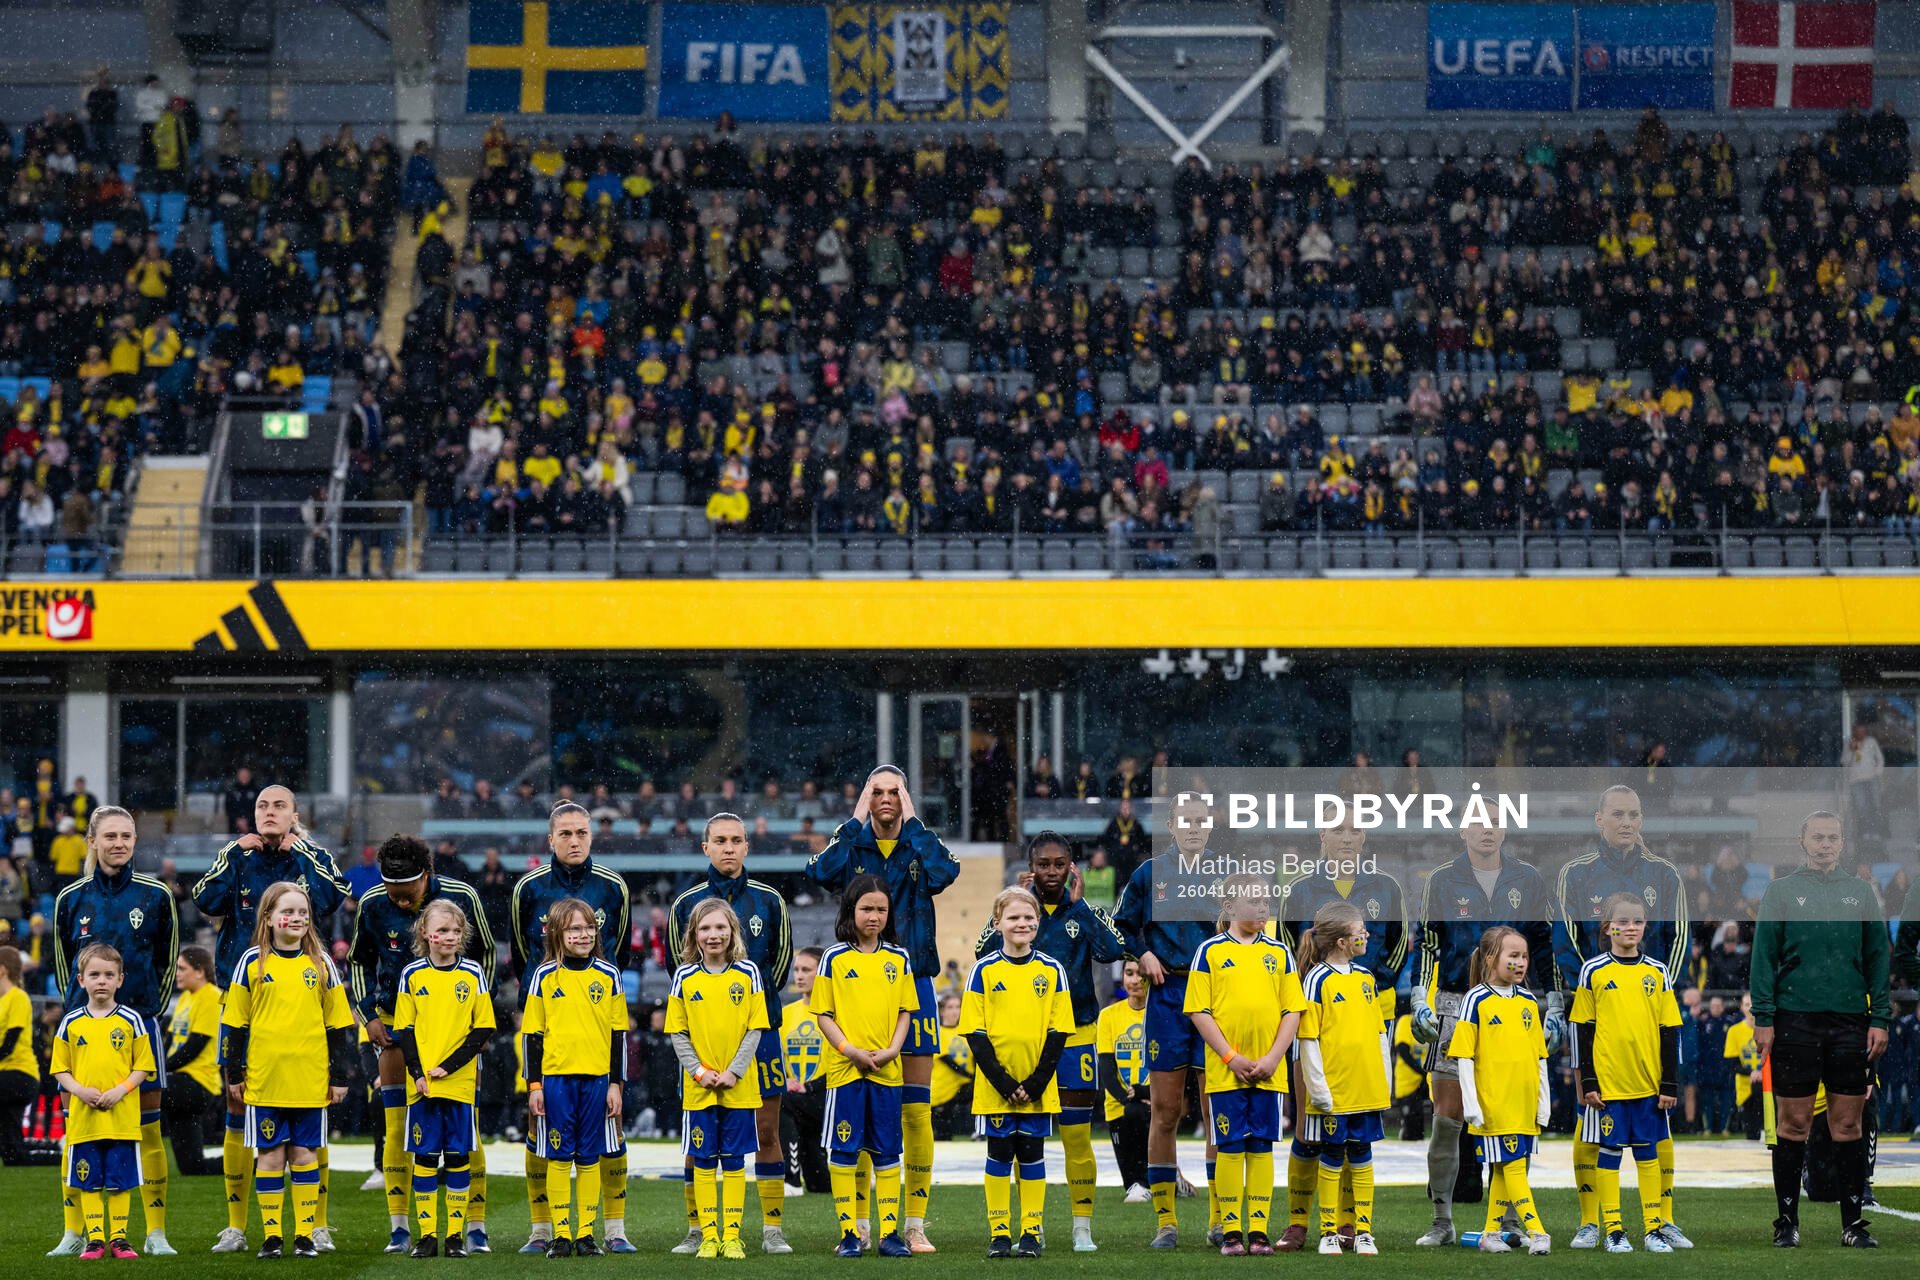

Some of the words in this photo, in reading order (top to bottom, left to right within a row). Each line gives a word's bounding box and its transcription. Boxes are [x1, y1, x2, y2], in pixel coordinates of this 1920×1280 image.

[686, 41, 807, 86] FIFA
[1434, 38, 1566, 76] UEFA
[1616, 45, 1713, 68] RESPECT
[0, 588, 95, 610] VENSKA
[0, 615, 41, 635] PEL
[912, 1017, 938, 1048] 14
[759, 1058, 785, 1090] 15
[1080, 1053, 1094, 1082] 6
[907, 1164, 931, 1173] SVERIGE
